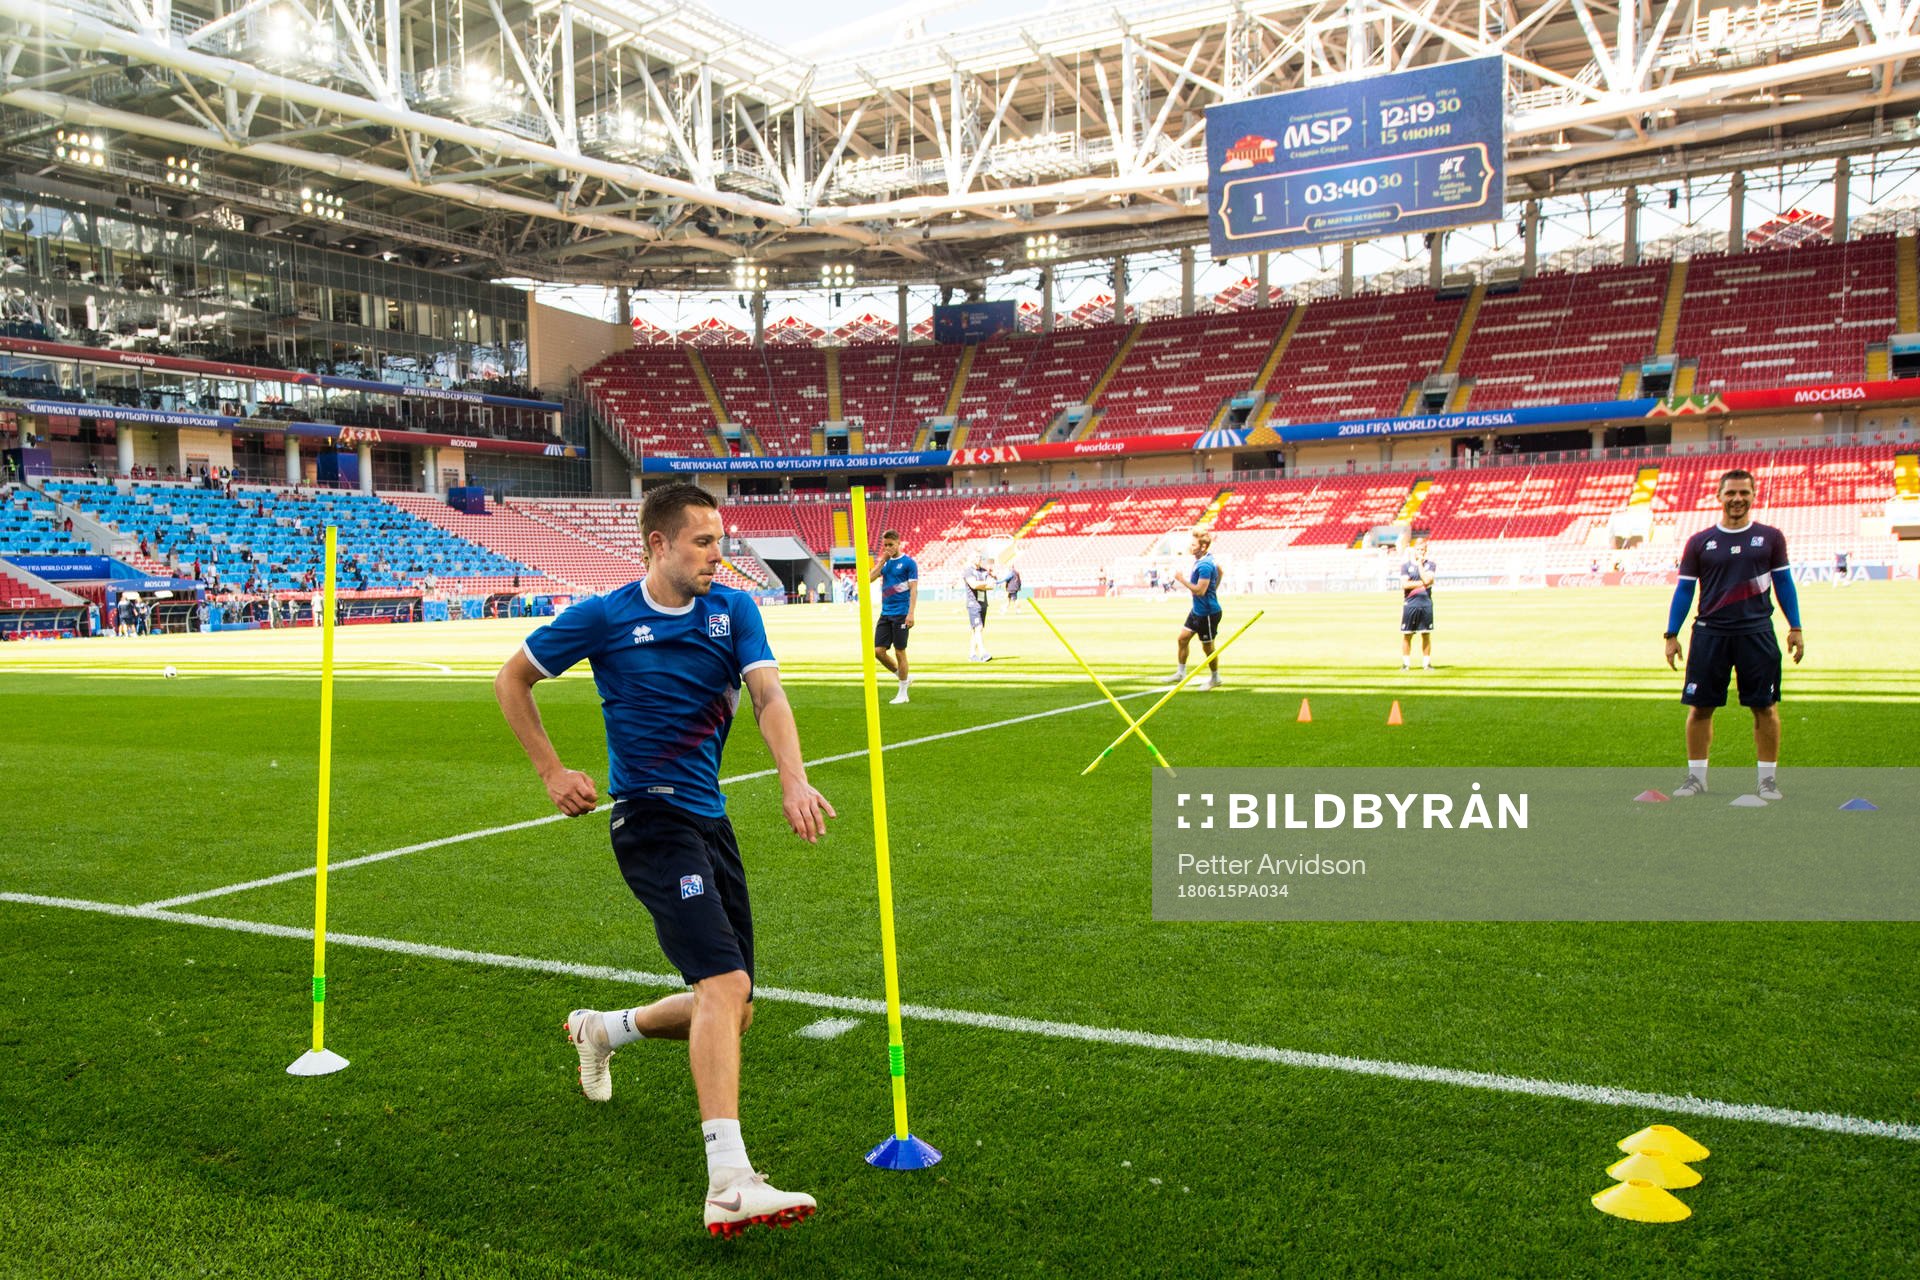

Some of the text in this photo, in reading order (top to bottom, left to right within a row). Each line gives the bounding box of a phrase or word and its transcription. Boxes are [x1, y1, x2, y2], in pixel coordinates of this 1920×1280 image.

[1380, 101, 1435, 128] 12:19
[1436, 97, 1461, 115] 30
[1283, 116, 1352, 150] MSP
[1381, 128, 1398, 145] 15
[1440, 156, 1465, 175] #7
[1304, 173, 1403, 205] 03:40 30
[1253, 192, 1264, 215] 1
[1314, 218, 1327, 229] До
[119, 354, 156, 366] #worldcup
[1794, 386, 1866, 403] МОСКВА
[26, 403, 218, 427] ЧЕМПИОНАТ МИРА ПО ФУТБОЛУ FIFA 2018 В РОССИИ
[1338, 412, 1514, 436] 2018 FIFA WORLD CUP RUSSIA
[450, 438, 478, 449] MOSCOW
[1074, 442, 1125, 453] #worldcup
[669, 455, 920, 470] ЧЕМПИОНАТ МИРА ПО ФУТБОЛУ FIFA 2018 В РОССИИ
[144, 580, 171, 588] MOSCOW
